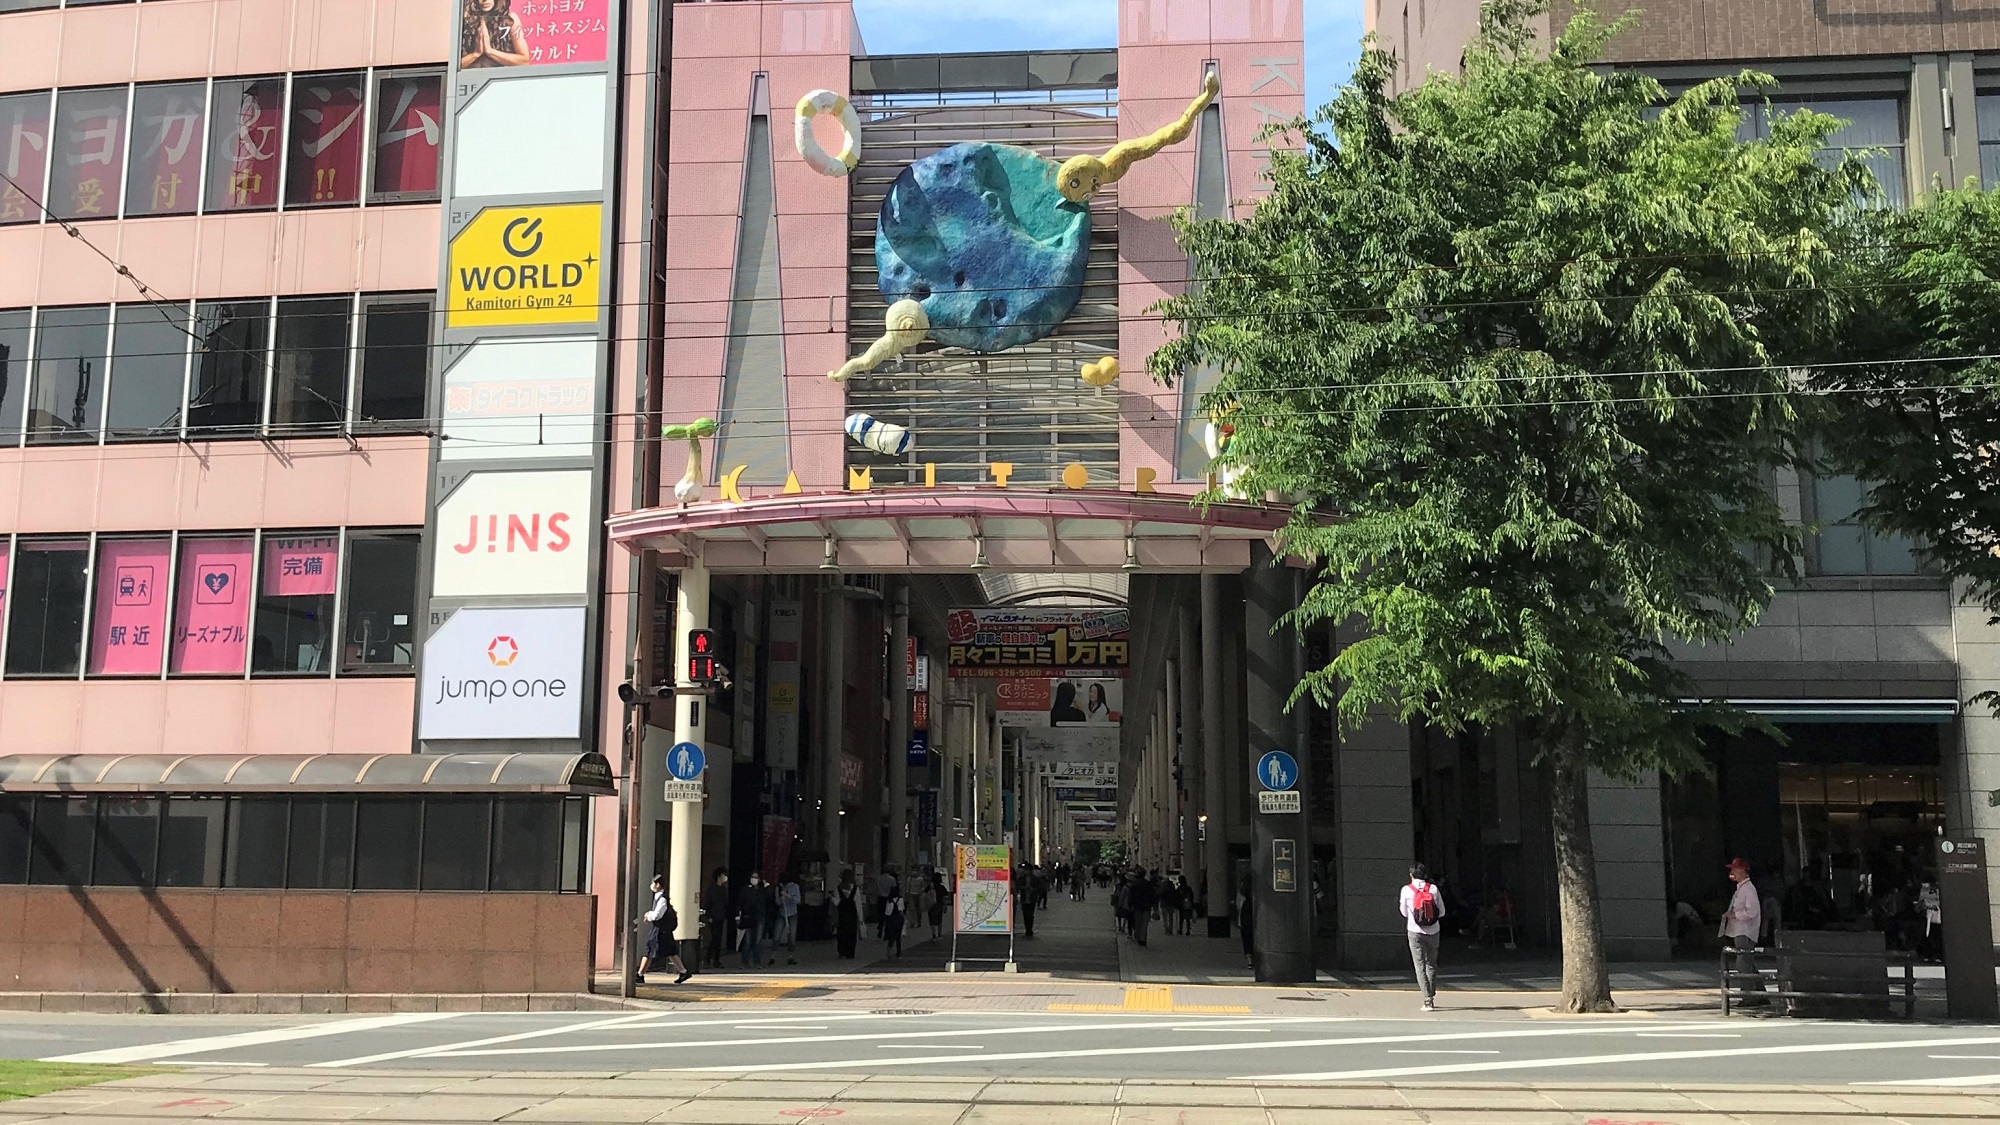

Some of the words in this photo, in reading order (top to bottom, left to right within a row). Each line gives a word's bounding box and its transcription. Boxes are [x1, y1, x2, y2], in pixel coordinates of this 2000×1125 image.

[522, 0, 585, 16] ホットヨガ
[498, 18, 605, 40] フィットネスジム
[530, 43, 579, 62] カルド
[458, 84, 477, 97] 3F
[452, 211, 471, 224] 2F
[460, 263, 583, 291] WORLD
[466, 296, 522, 311] Kamitori
[526, 295, 554, 310] Gym
[558, 294, 573, 307] 24
[283, 557, 323, 576] 完備
[109, 625, 150, 646] 駅近
[178, 626, 245, 644] リーズナブル
[436, 676, 507, 705] jump
[513, 679, 566, 698] one
